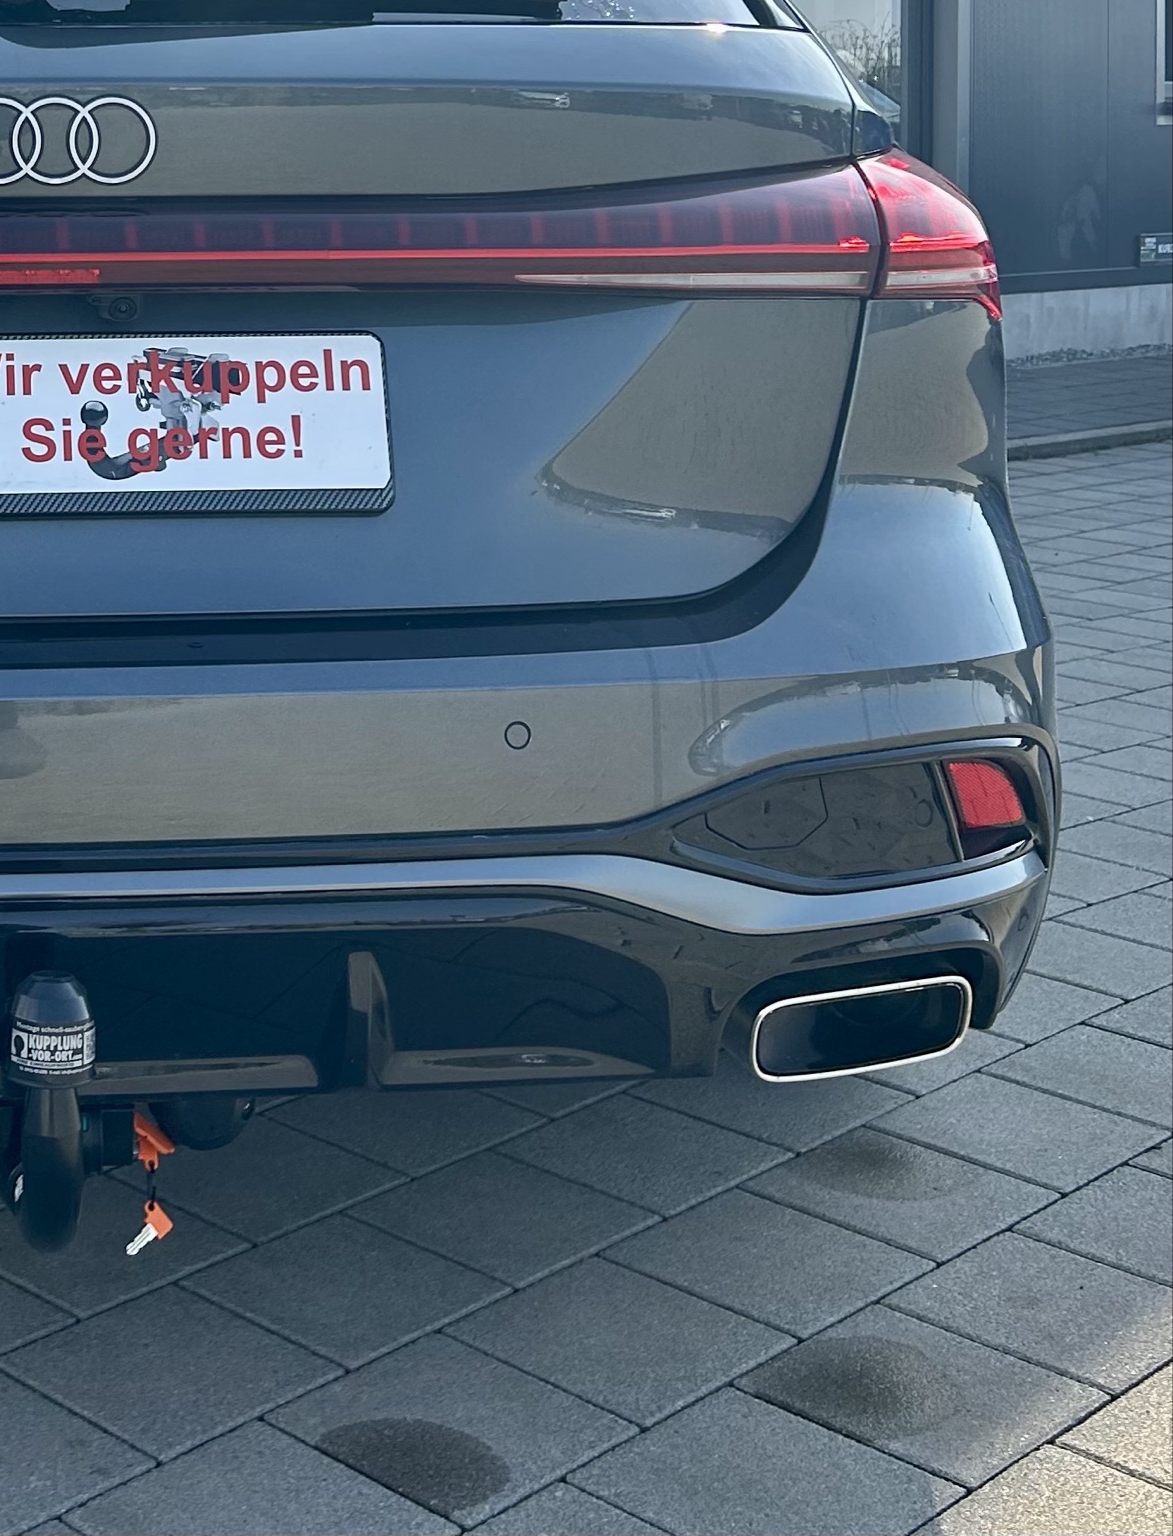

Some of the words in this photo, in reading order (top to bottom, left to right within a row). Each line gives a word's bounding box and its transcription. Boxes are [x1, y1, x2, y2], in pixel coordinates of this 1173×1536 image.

[59, 349, 371, 404] verkuppeln
[21, 417, 107, 463] Sie
[128, 414, 303, 473] gerne!
[28, 1033, 83, 1051] KUPPLUNG
